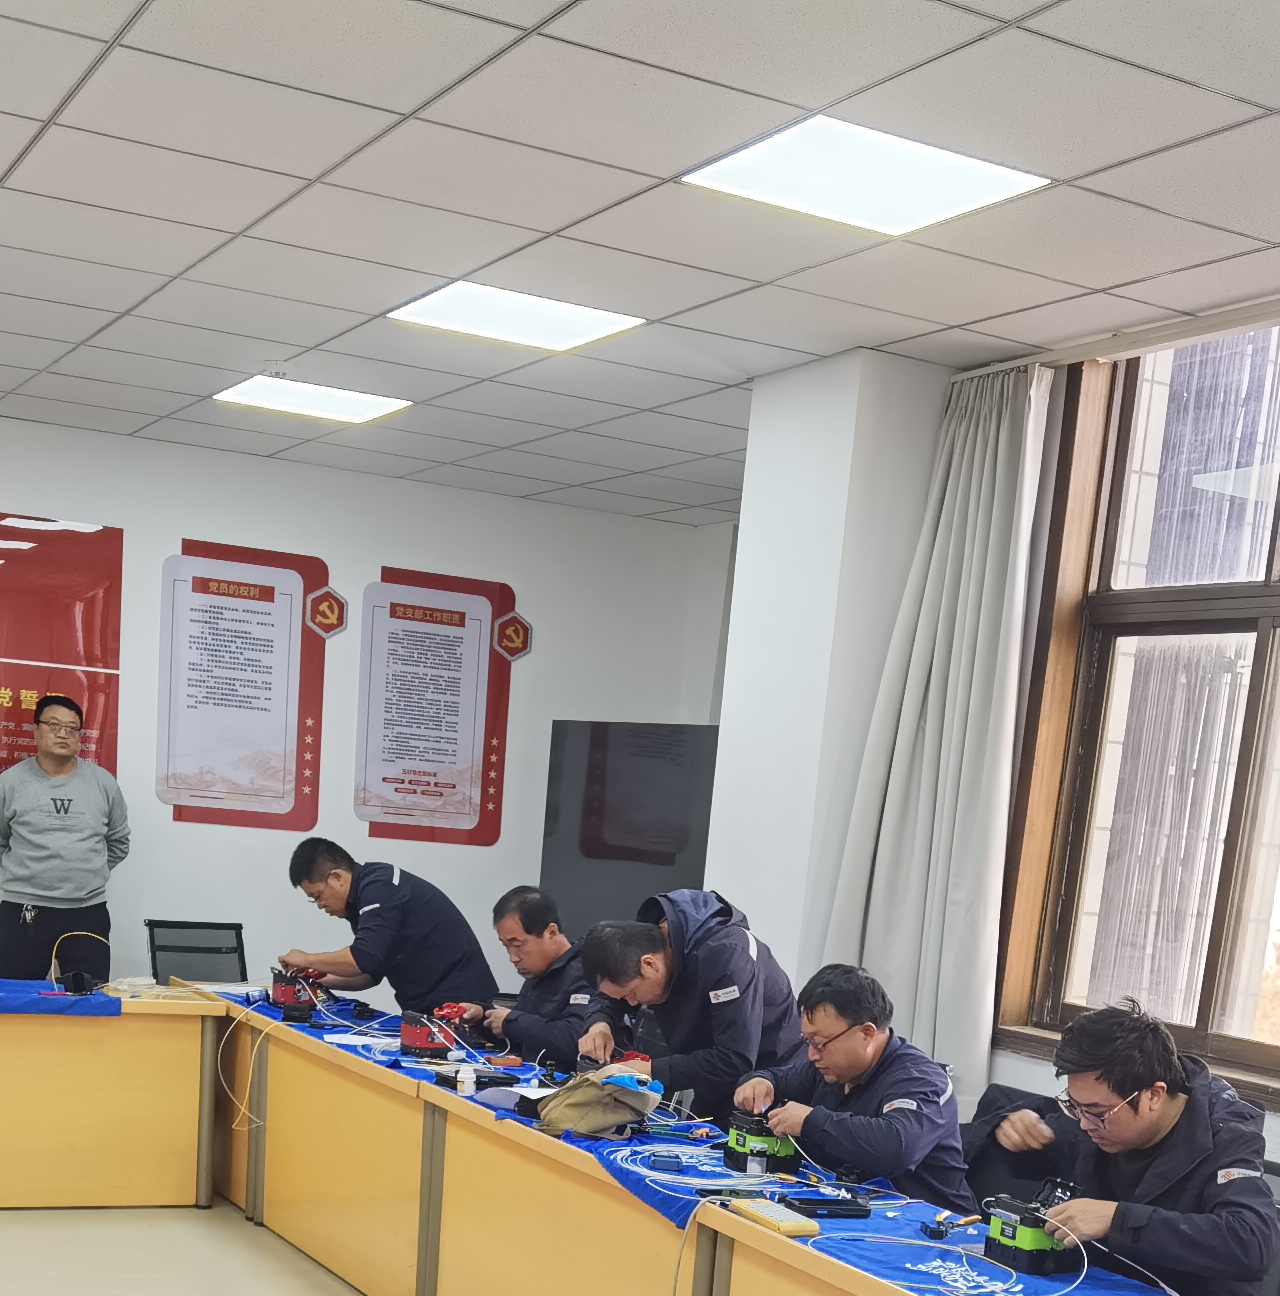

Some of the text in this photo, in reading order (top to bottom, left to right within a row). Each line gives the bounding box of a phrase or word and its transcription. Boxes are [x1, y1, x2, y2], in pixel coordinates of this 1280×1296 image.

[208, 580, 260, 599] 党员的权利
[395, 605, 461, 624] 党支部工作职责
[50, 797, 74, 815] W
